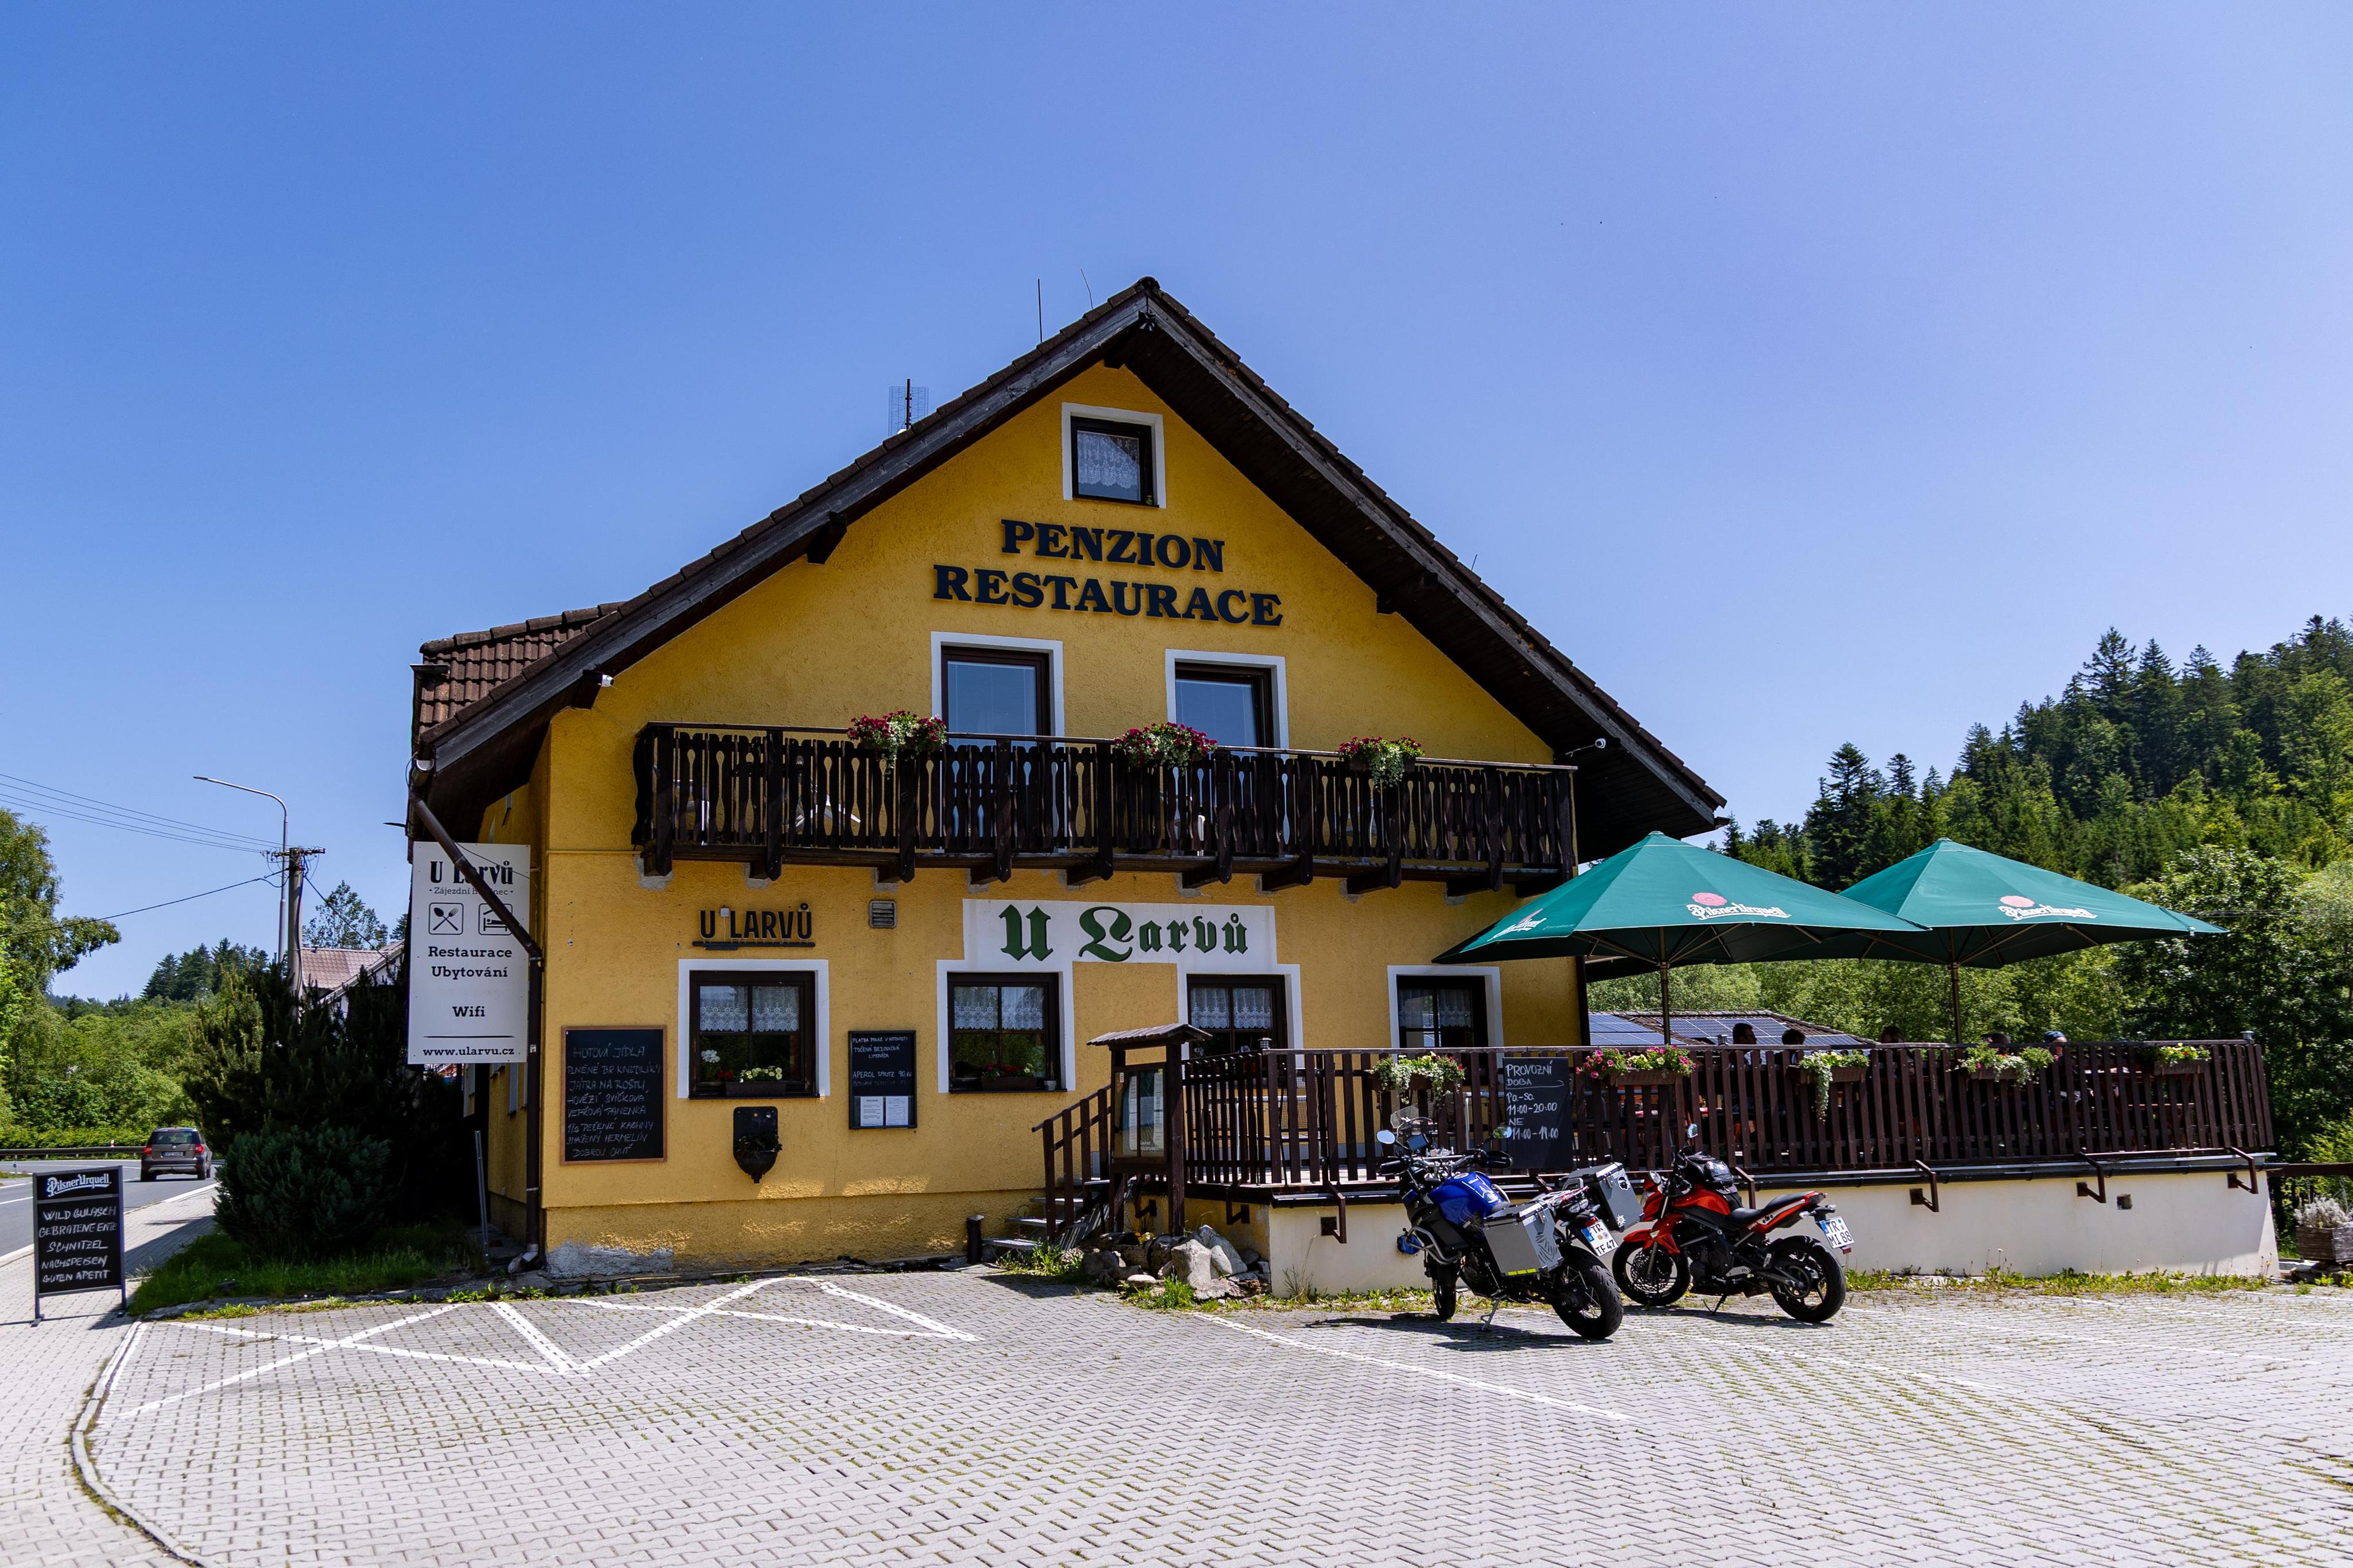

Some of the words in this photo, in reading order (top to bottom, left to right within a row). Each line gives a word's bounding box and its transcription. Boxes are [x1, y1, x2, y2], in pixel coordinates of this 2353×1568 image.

[1001, 519, 1225, 572] PENZION
[933, 564, 1283, 626] RESTAURACE
[430, 861, 443, 883] U
[454, 860, 513, 885] Lrvů
[434, 887, 470, 895] Zájezdní
[700, 910, 715, 939] U
[730, 903, 812, 939] LARVŮ
[998, 904, 1054, 961] U
[1078, 906, 1248, 962] Larvů
[428, 946, 512, 958] Restaurace
[432, 966, 508, 980] Ubytování
[452, 1006, 485, 1017] Wifi
[423, 1046, 514, 1056] www.ularvu.cz
[574, 1043, 611, 1057] HOTOVÁ
[612, 1045, 645, 1057] JÍDLA
[1505, 1060, 1553, 1077] PROVOZNÍ
[599, 1080, 612, 1089] NA
[1507, 1078, 1532, 1086] DOBA
[1508, 1117, 1524, 1126] NE
[47, 1177, 79, 1197] Pilsner
[78, 1173, 109, 1189] Urquell
[43, 1210, 71, 1221] WILD
[73, 1206, 116, 1218] GULASCH
[1591, 1223, 1604, 1233] TR
[1826, 1221, 1840, 1233] TR
[1828, 1233, 1842, 1246] MI
[1840, 1230, 1852, 1243] 88
[46, 1239, 109, 1253] SCHNITZEL
[1595, 1244, 1606, 1255] TF
[1606, 1239, 1615, 1249] 47
[41, 1255, 108, 1270] NACHSPEISEN
[42, 1273, 73, 1283] GUTEN
[76, 1269, 112, 1280] APETIT
